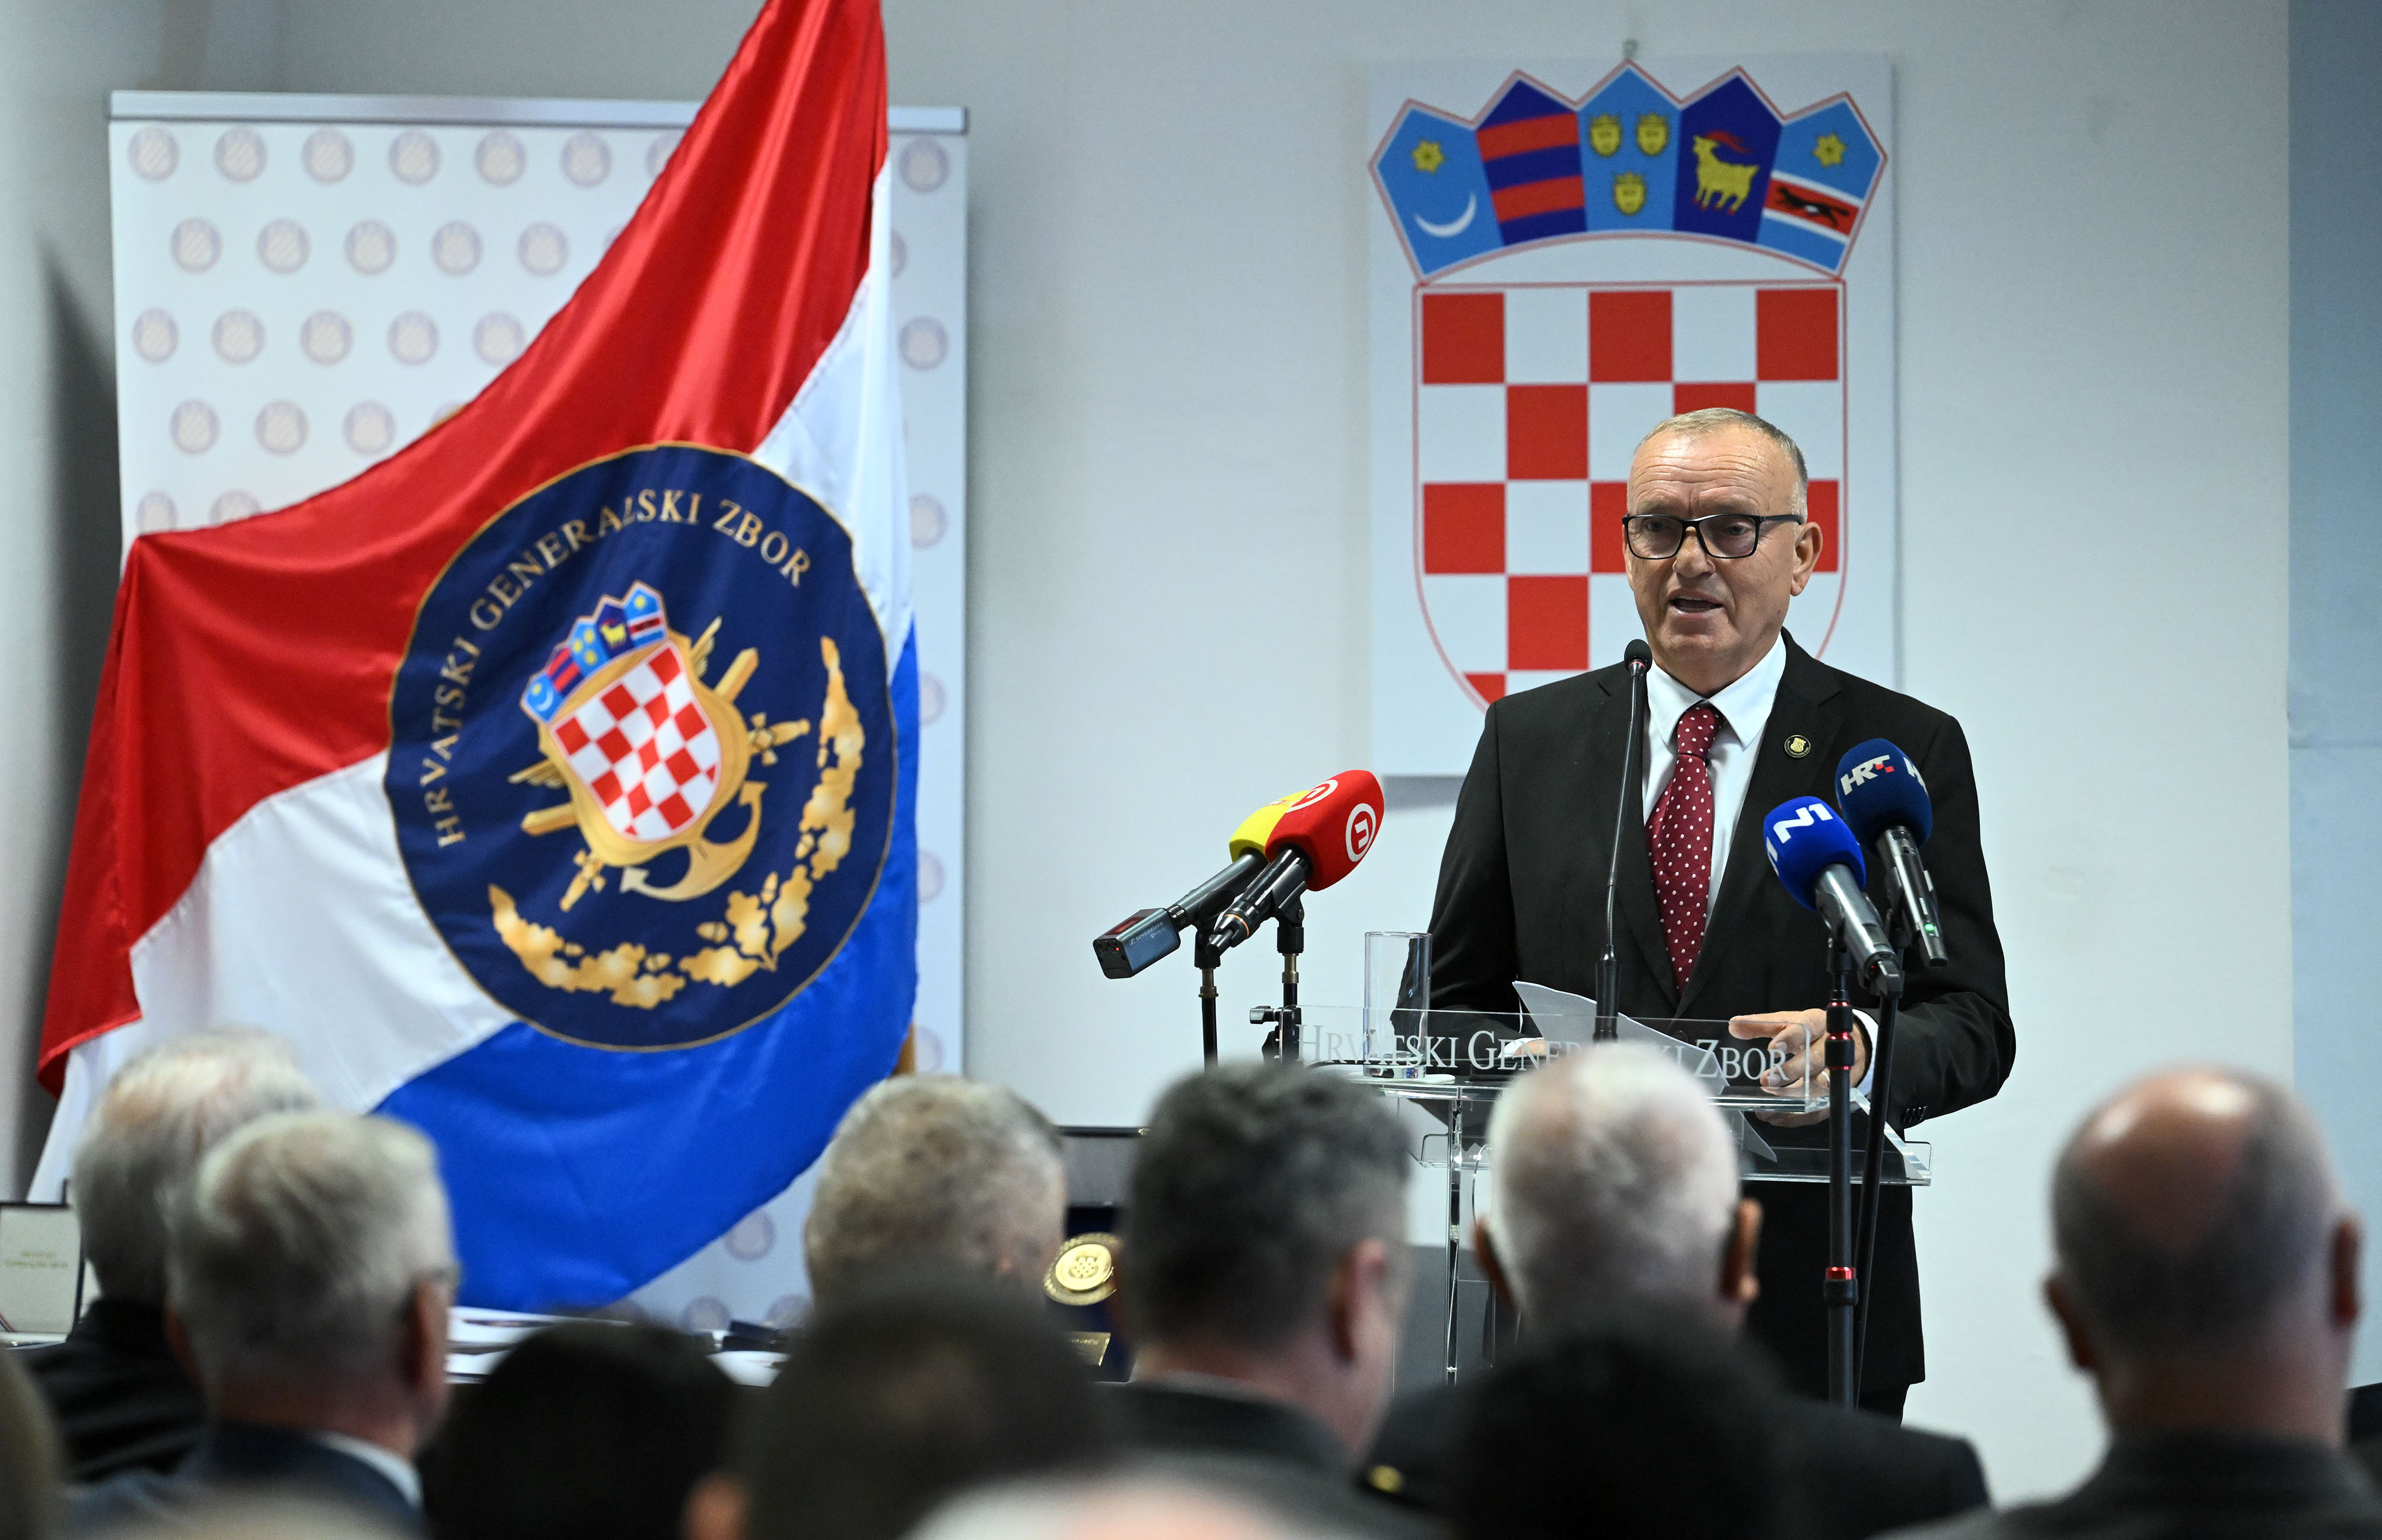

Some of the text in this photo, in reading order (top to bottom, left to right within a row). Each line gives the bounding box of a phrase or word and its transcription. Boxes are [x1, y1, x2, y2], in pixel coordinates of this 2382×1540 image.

[420, 489, 811, 848] HRVATSKI GENERALSKI ZBOR
[1840, 755, 1893, 795] HRT
[1773, 804, 1833, 844] N1
[1694, 1039, 1791, 1082] ZBOR
